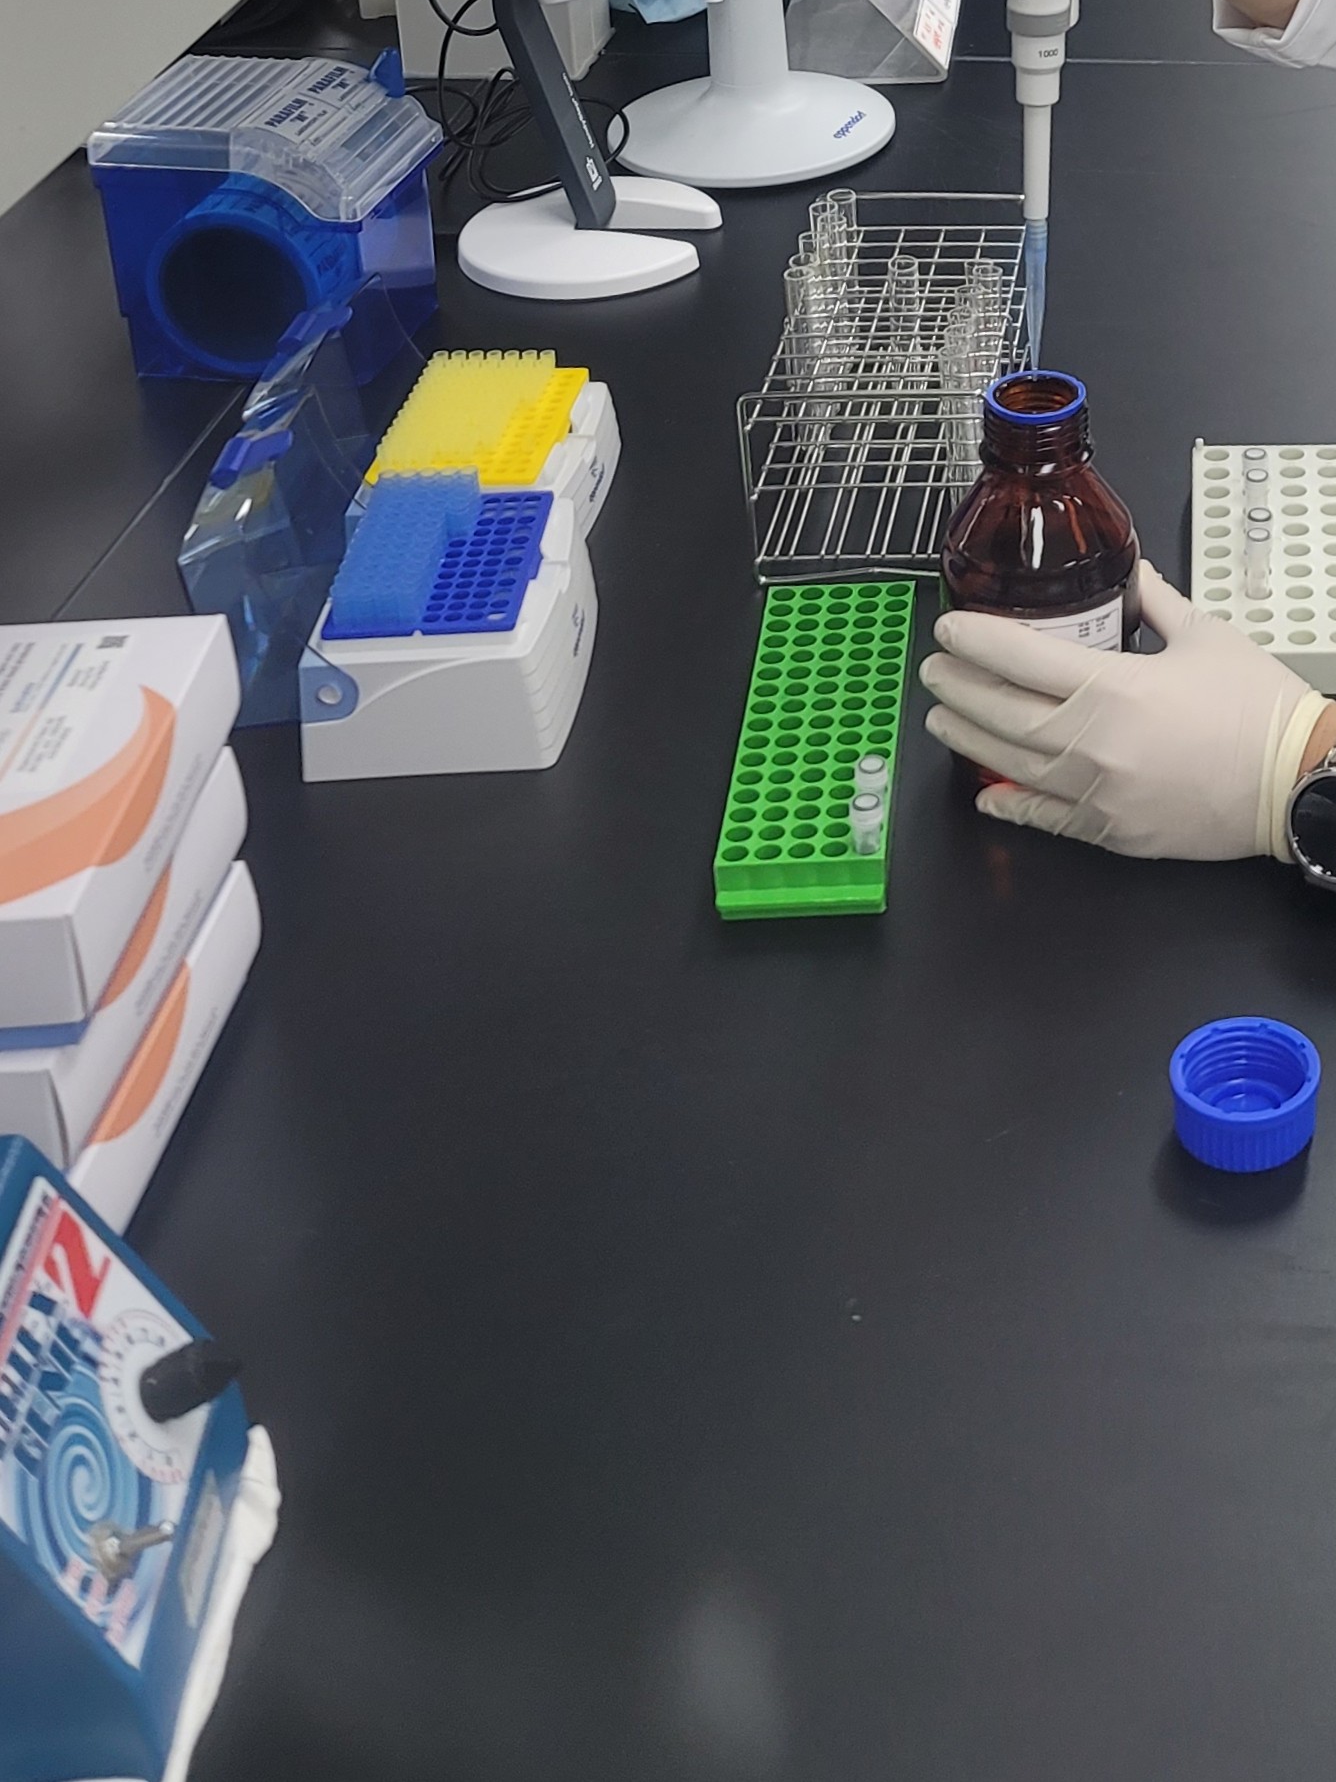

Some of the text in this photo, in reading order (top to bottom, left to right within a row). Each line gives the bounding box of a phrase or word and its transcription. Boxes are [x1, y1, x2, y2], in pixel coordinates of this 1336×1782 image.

[1038, 48, 1059, 58] 1000
[307, 66, 350, 95] PARAFILM
[264, 97, 308, 128] PARAFILM
[833, 110, 867, 139] eppendorf
[43, 1210, 110, 1320] 2
